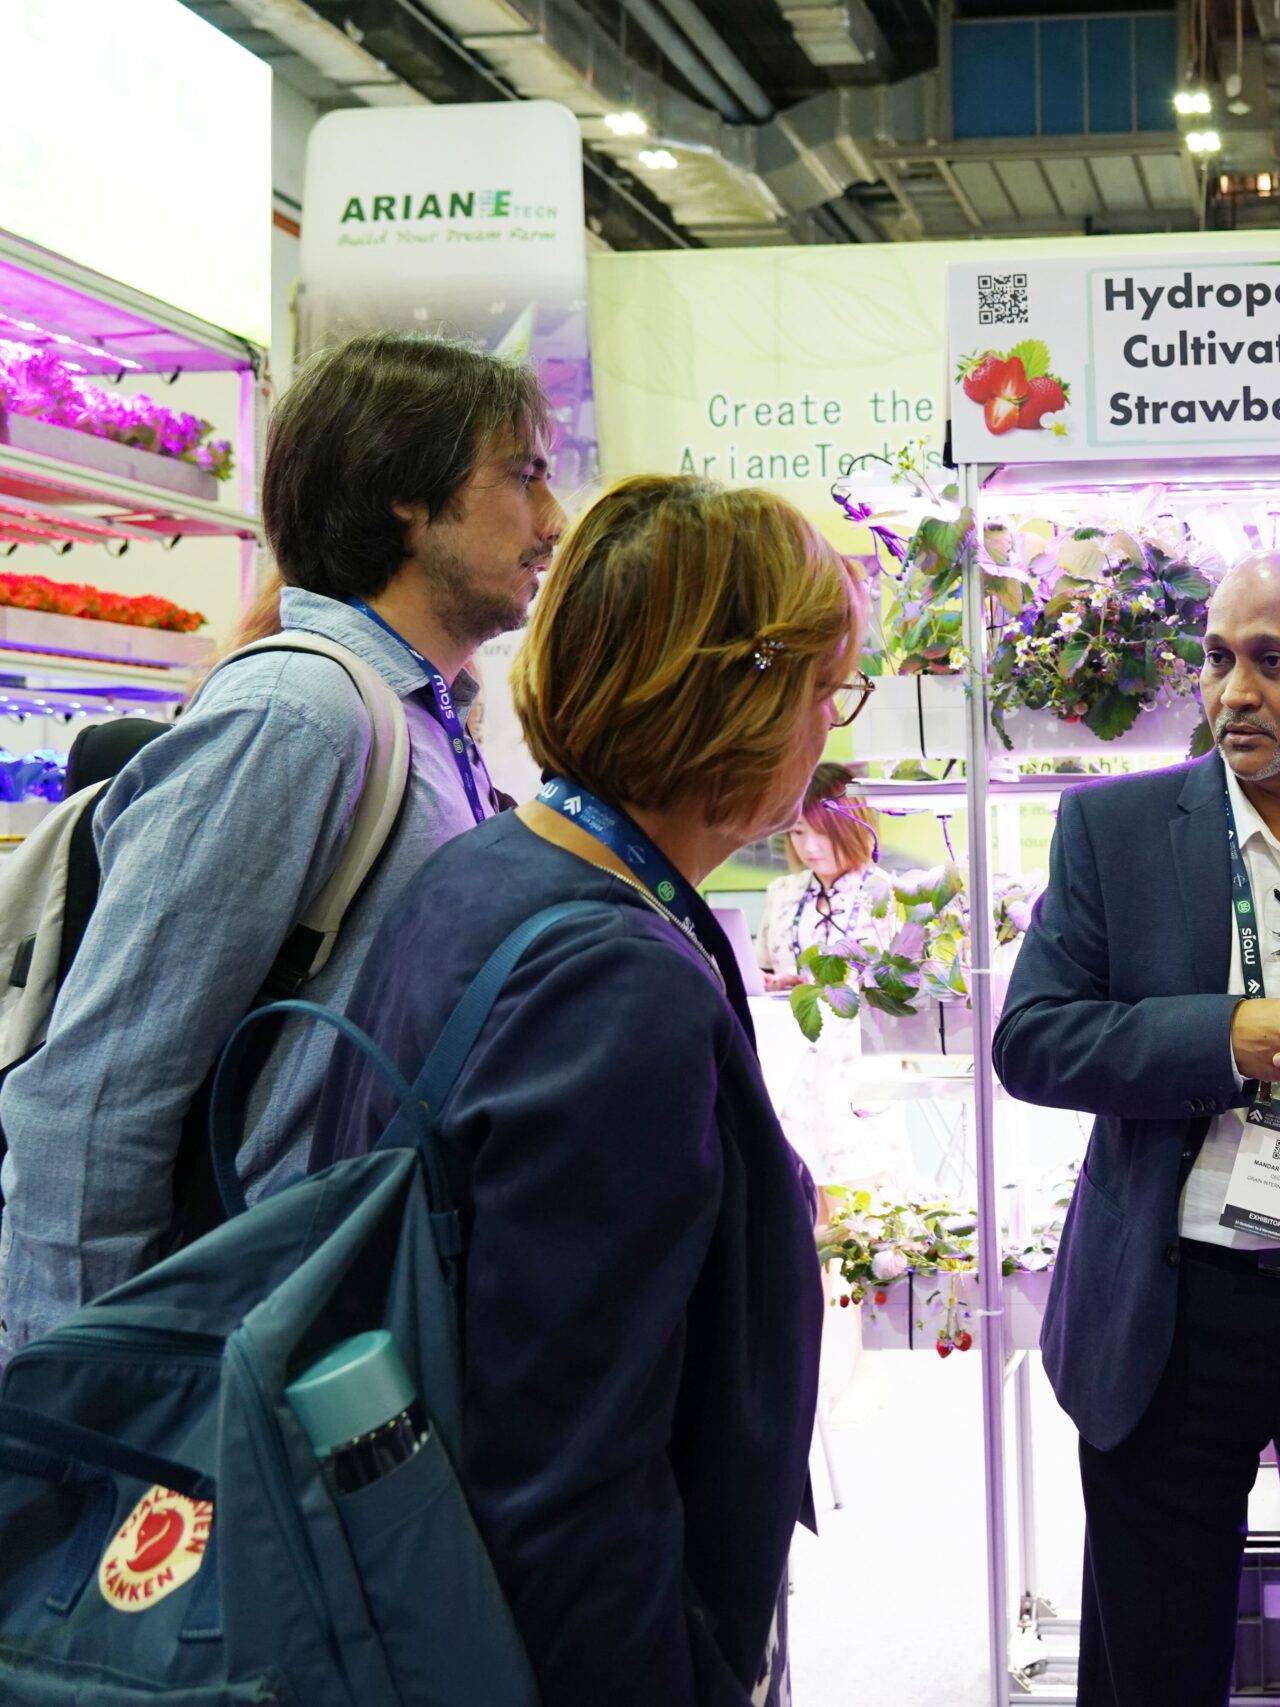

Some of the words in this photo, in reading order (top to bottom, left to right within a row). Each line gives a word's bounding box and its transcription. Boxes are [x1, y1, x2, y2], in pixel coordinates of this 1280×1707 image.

[708, 394, 842, 427] Create
[869, 390, 933, 424] the
[1254, 1159, 1280, 1171] MANDAR
